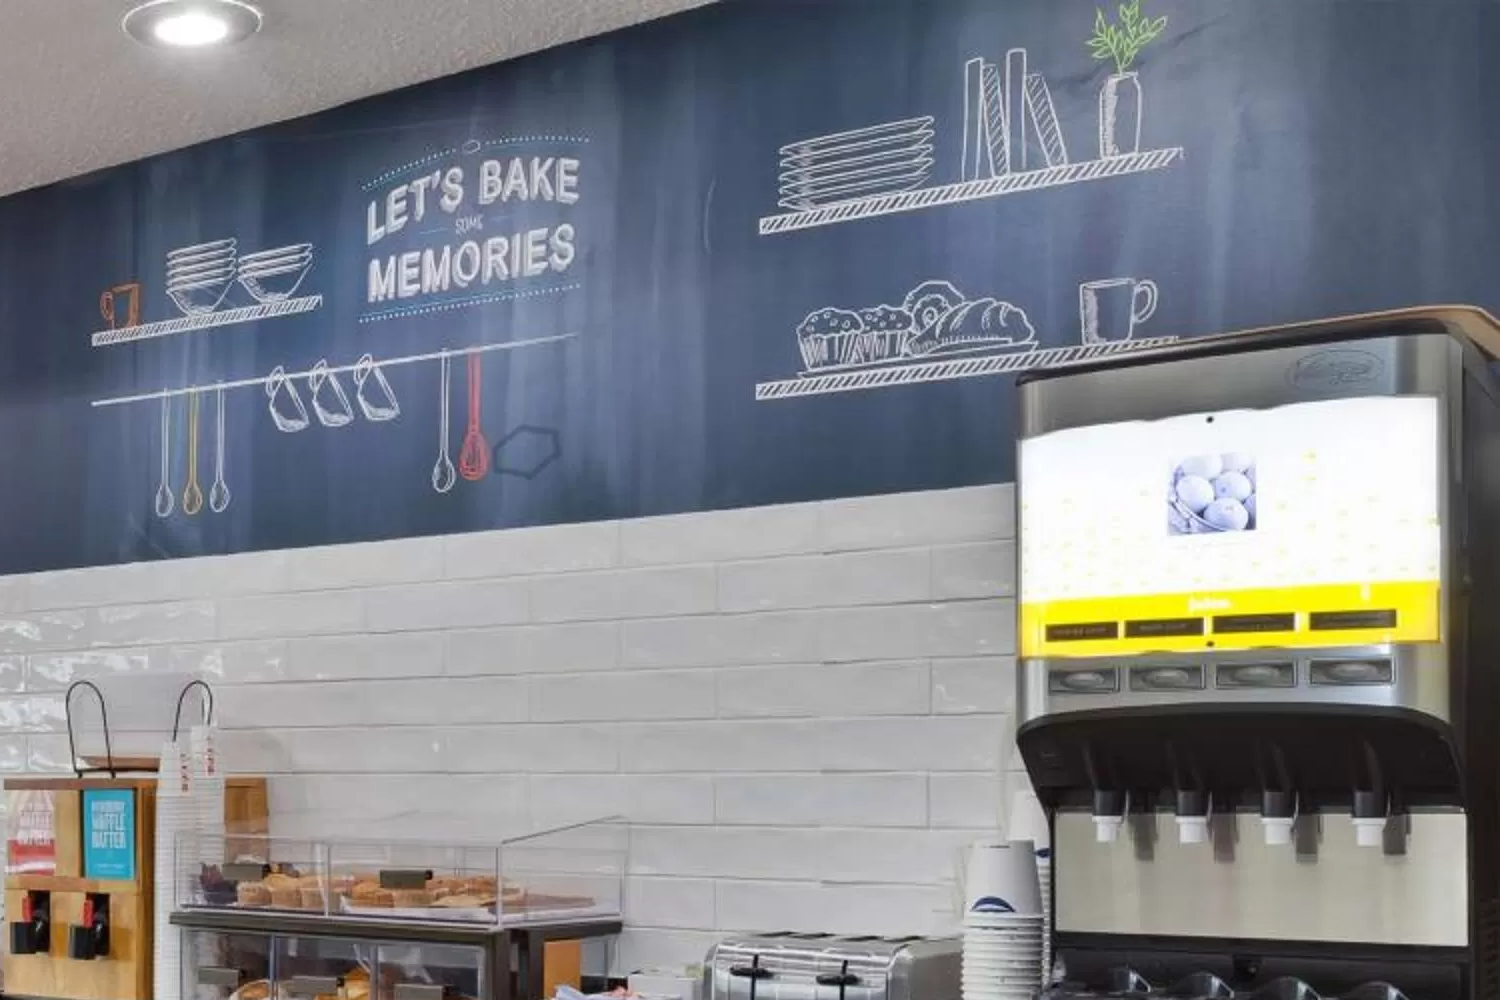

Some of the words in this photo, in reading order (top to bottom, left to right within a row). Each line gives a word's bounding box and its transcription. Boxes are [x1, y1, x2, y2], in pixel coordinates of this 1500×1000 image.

[367, 166, 464, 245] LET'S
[478, 157, 580, 205] BAKE
[367, 223, 575, 303] MEMORIES
